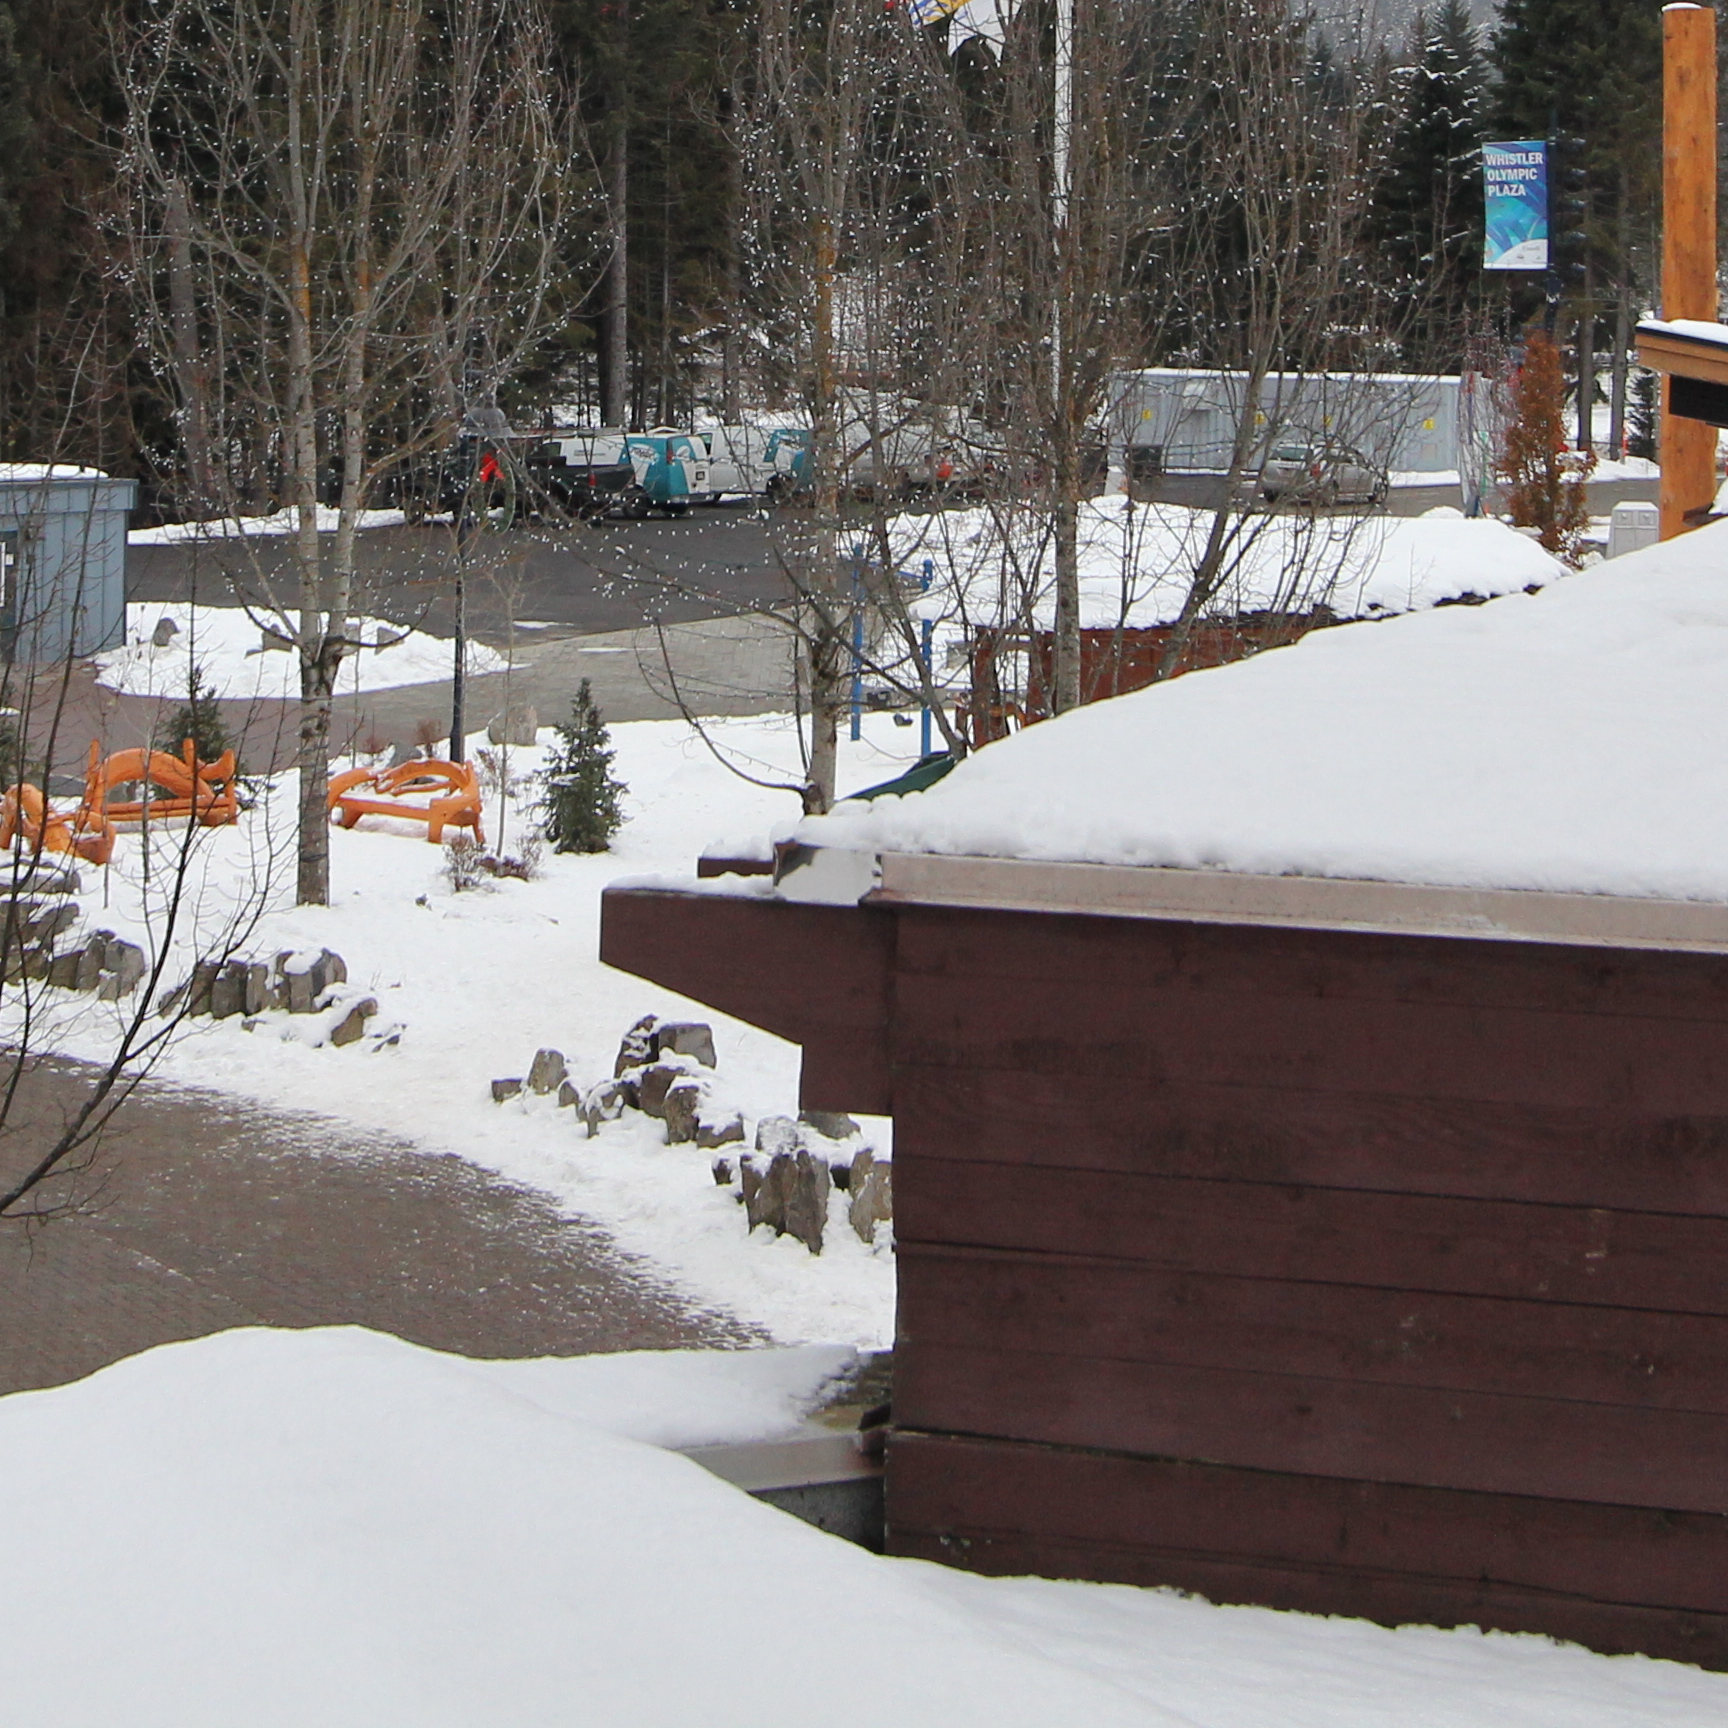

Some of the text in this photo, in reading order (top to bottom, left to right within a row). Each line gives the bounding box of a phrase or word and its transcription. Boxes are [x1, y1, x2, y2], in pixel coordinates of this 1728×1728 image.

[1485, 152, 1543, 166] WHISTLER
[1487, 168, 1538, 182] OLYMPIC
[1488, 183, 1526, 197] PLAZA
